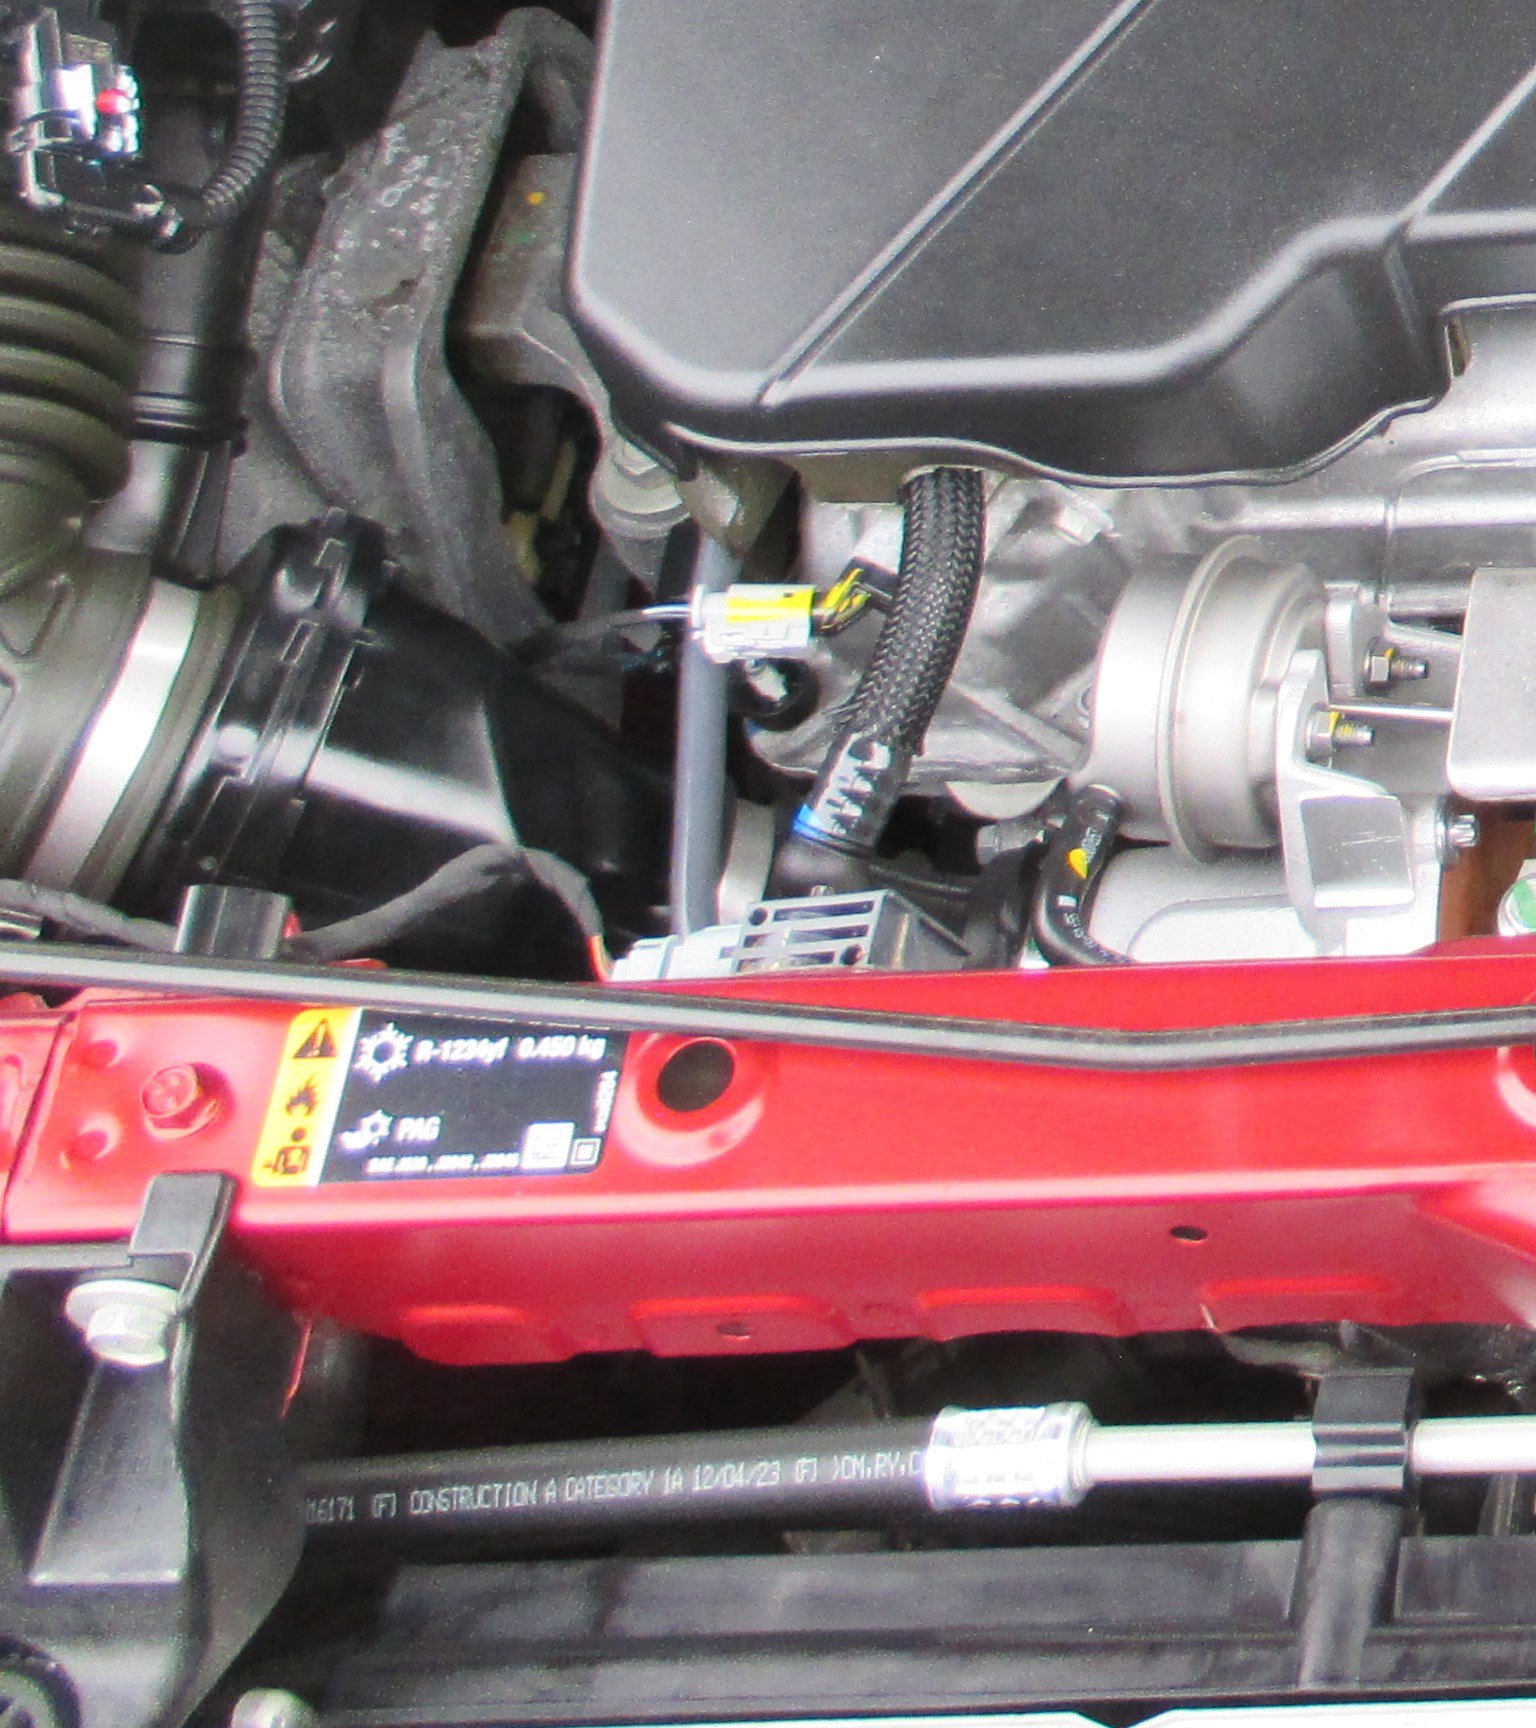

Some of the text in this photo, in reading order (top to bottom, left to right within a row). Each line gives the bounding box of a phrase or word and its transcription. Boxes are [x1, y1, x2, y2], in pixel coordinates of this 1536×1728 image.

[515, 1034, 577, 1060] 0.450
[576, 1033, 607, 1061] kg
[395, 1116, 442, 1142] PAG
[409, 1479, 539, 1515] CONSTRUCTION
[544, 1476, 557, 1505] A
[564, 1470, 653, 1502] CATEGORY
[692, 1460, 781, 1491] 12/04/23
